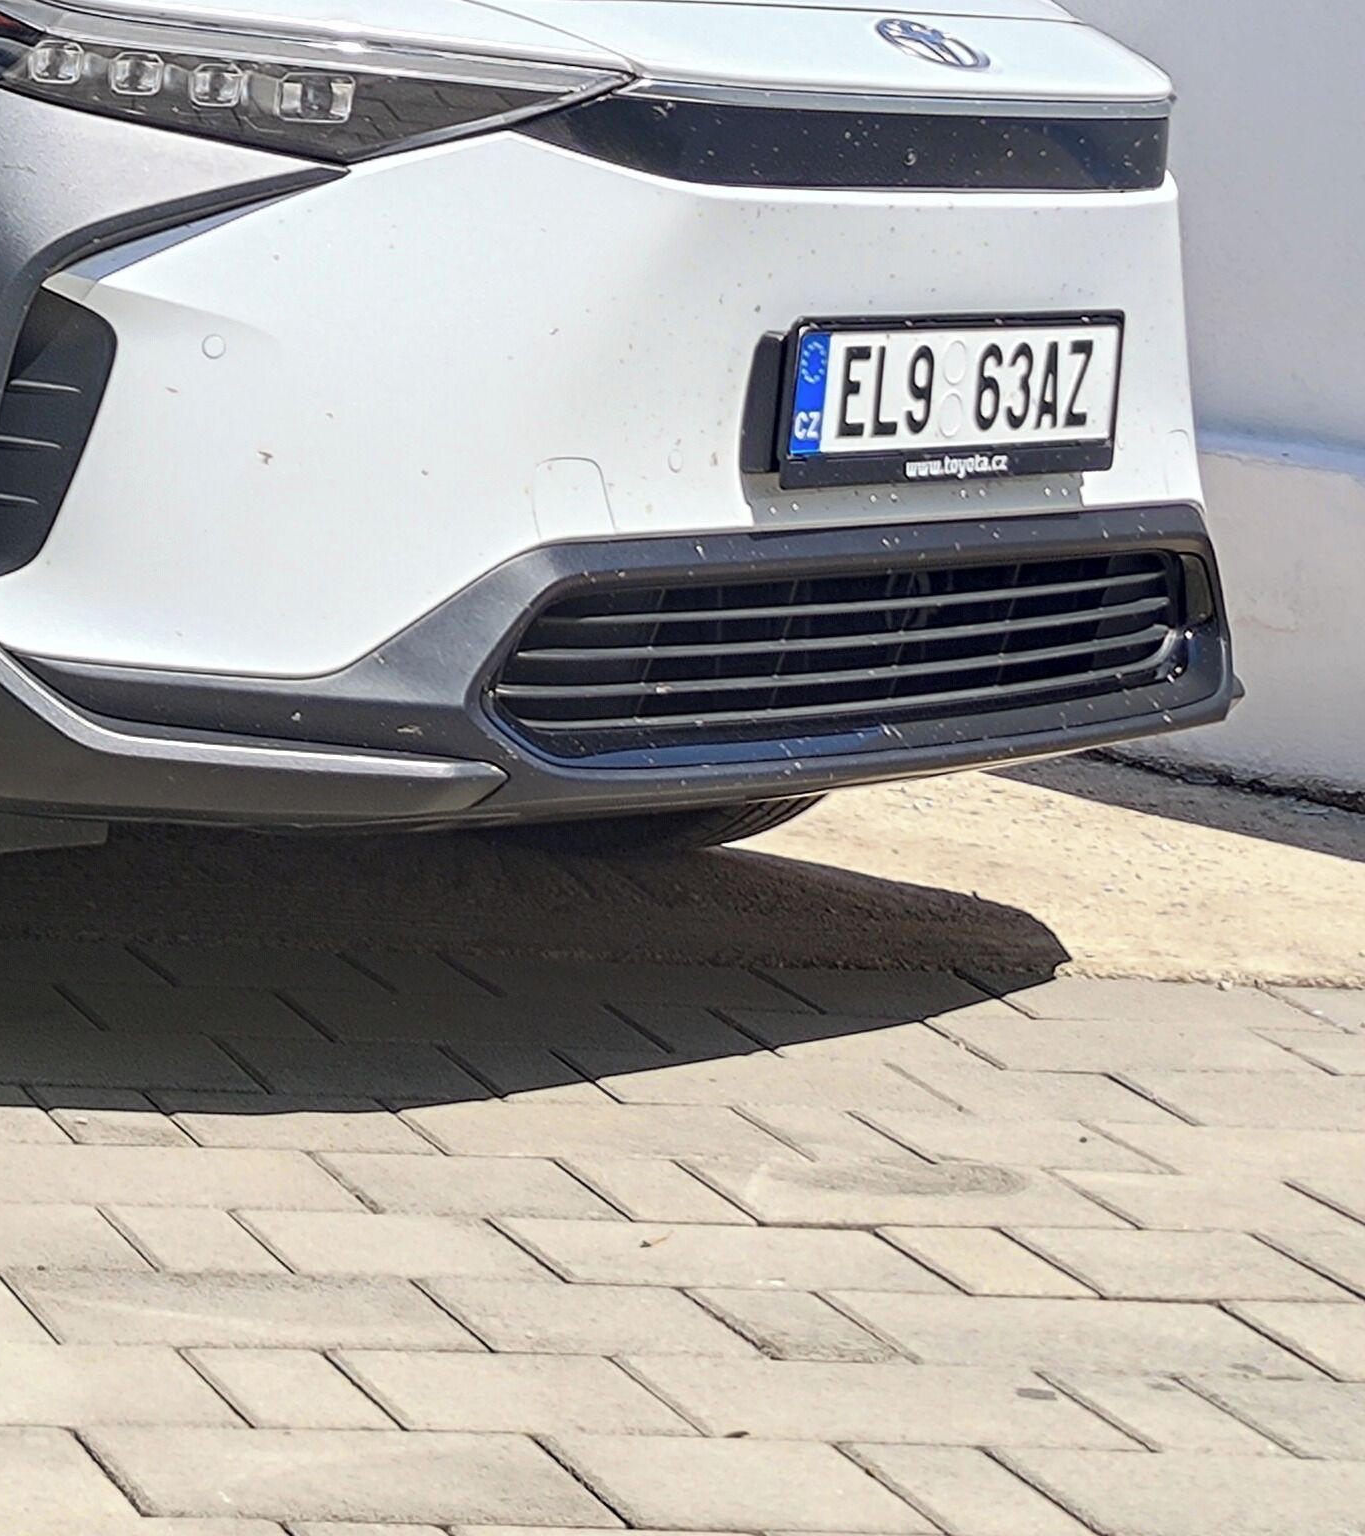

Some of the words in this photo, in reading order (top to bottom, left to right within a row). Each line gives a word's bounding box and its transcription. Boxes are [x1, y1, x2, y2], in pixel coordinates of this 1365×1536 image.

[835, 344, 936, 439] EL9
[974, 339, 1094, 431] 63AZ
[793, 410, 822, 442] CZ
[905, 453, 1009, 479] www.toyota.cz
